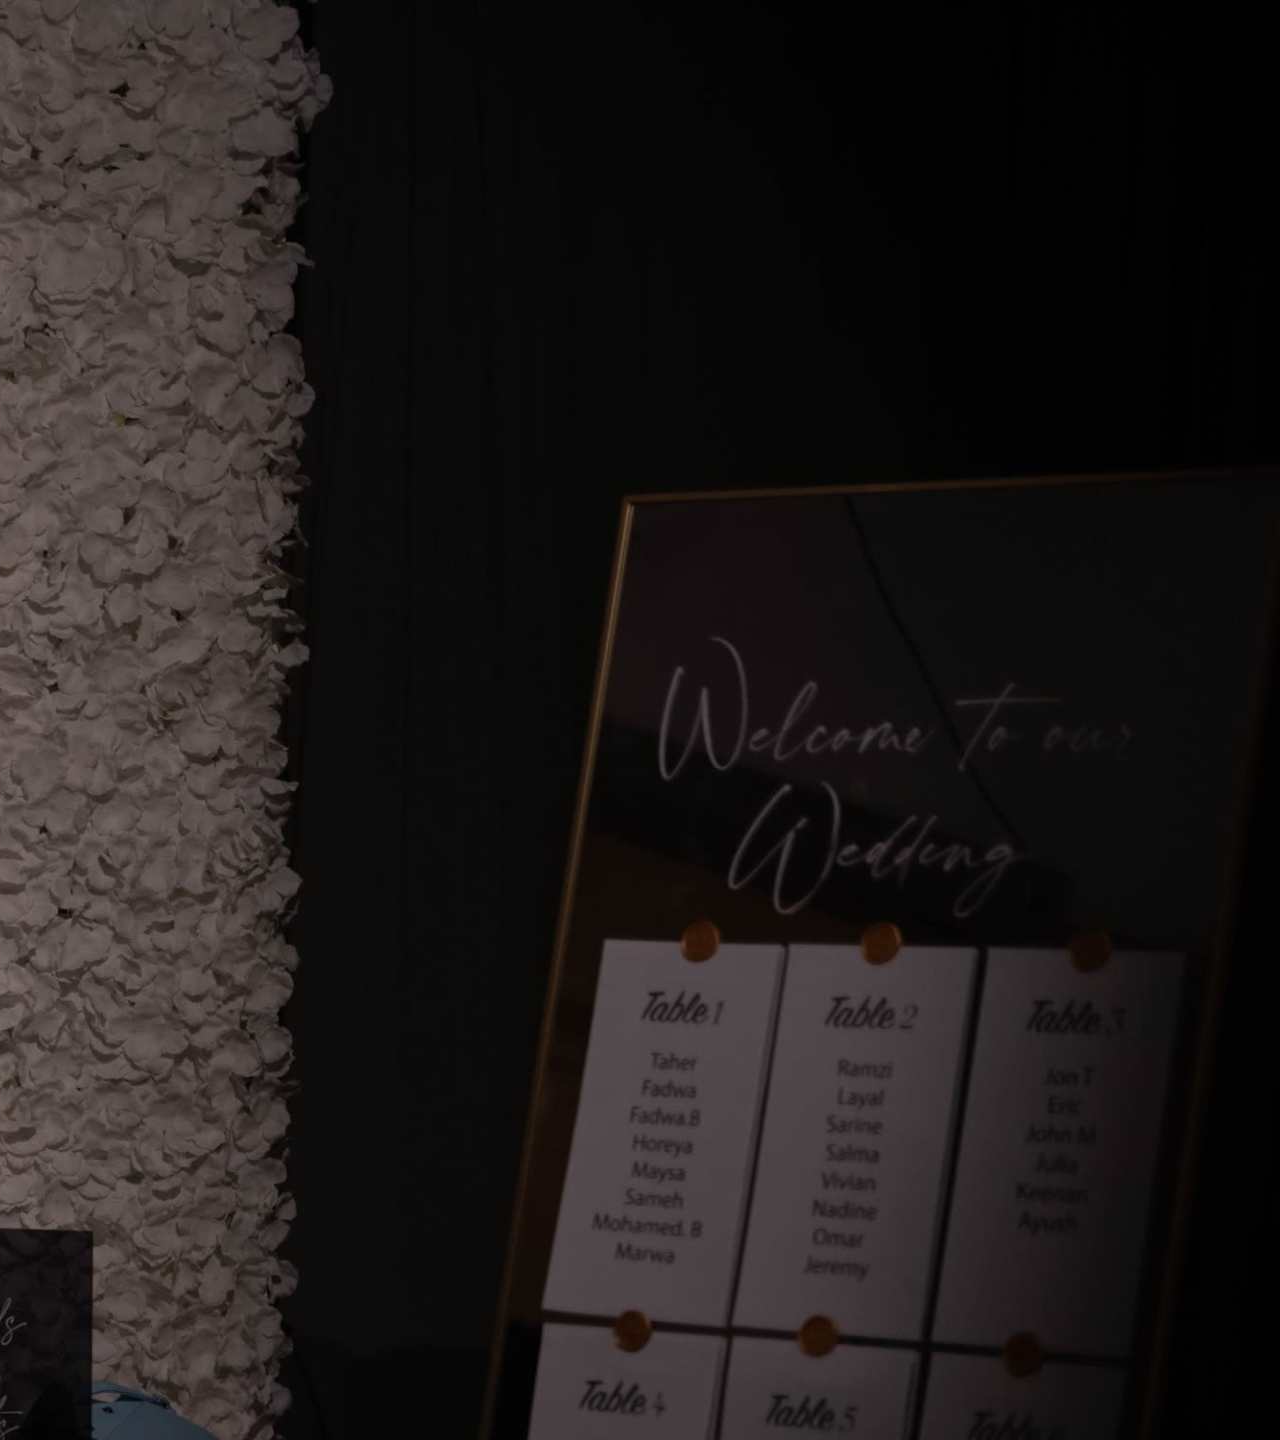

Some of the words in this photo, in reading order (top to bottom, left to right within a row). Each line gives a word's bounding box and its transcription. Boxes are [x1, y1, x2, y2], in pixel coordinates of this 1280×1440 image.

[658, 636, 936, 783] Welcome
[953, 682, 1064, 772] to
[727, 781, 1021, 918] Wedding
[640, 990, 710, 1024] Table
[712, 1000, 725, 1025] 1
[825, 995, 895, 1030] Table
[898, 1004, 920, 1032] 2
[1026, 999, 1101, 1033] Table
[651, 1051, 697, 1073] Taher
[838, 1058, 894, 1079] Ramzi
[641, 1079, 697, 1099] Fadwa
[837, 1087, 886, 1110] Layal
[826, 1114, 885, 1136] Sarine
[632, 1134, 695, 1158] Horeya
[826, 1143, 881, 1165] Salma
[630, 1161, 687, 1184] Maysa
[624, 1188, 684, 1209] Sameh
[811, 1199, 879, 1221] Nadine
[812, 1227, 864, 1248] Omar
[614, 1243, 676, 1266] Marwa
[803, 1255, 871, 1283] Jeremy
[580, 1379, 647, 1415] Table
[766, 1394, 836, 1431] Table
[839, 1404, 859, 1433] 5
